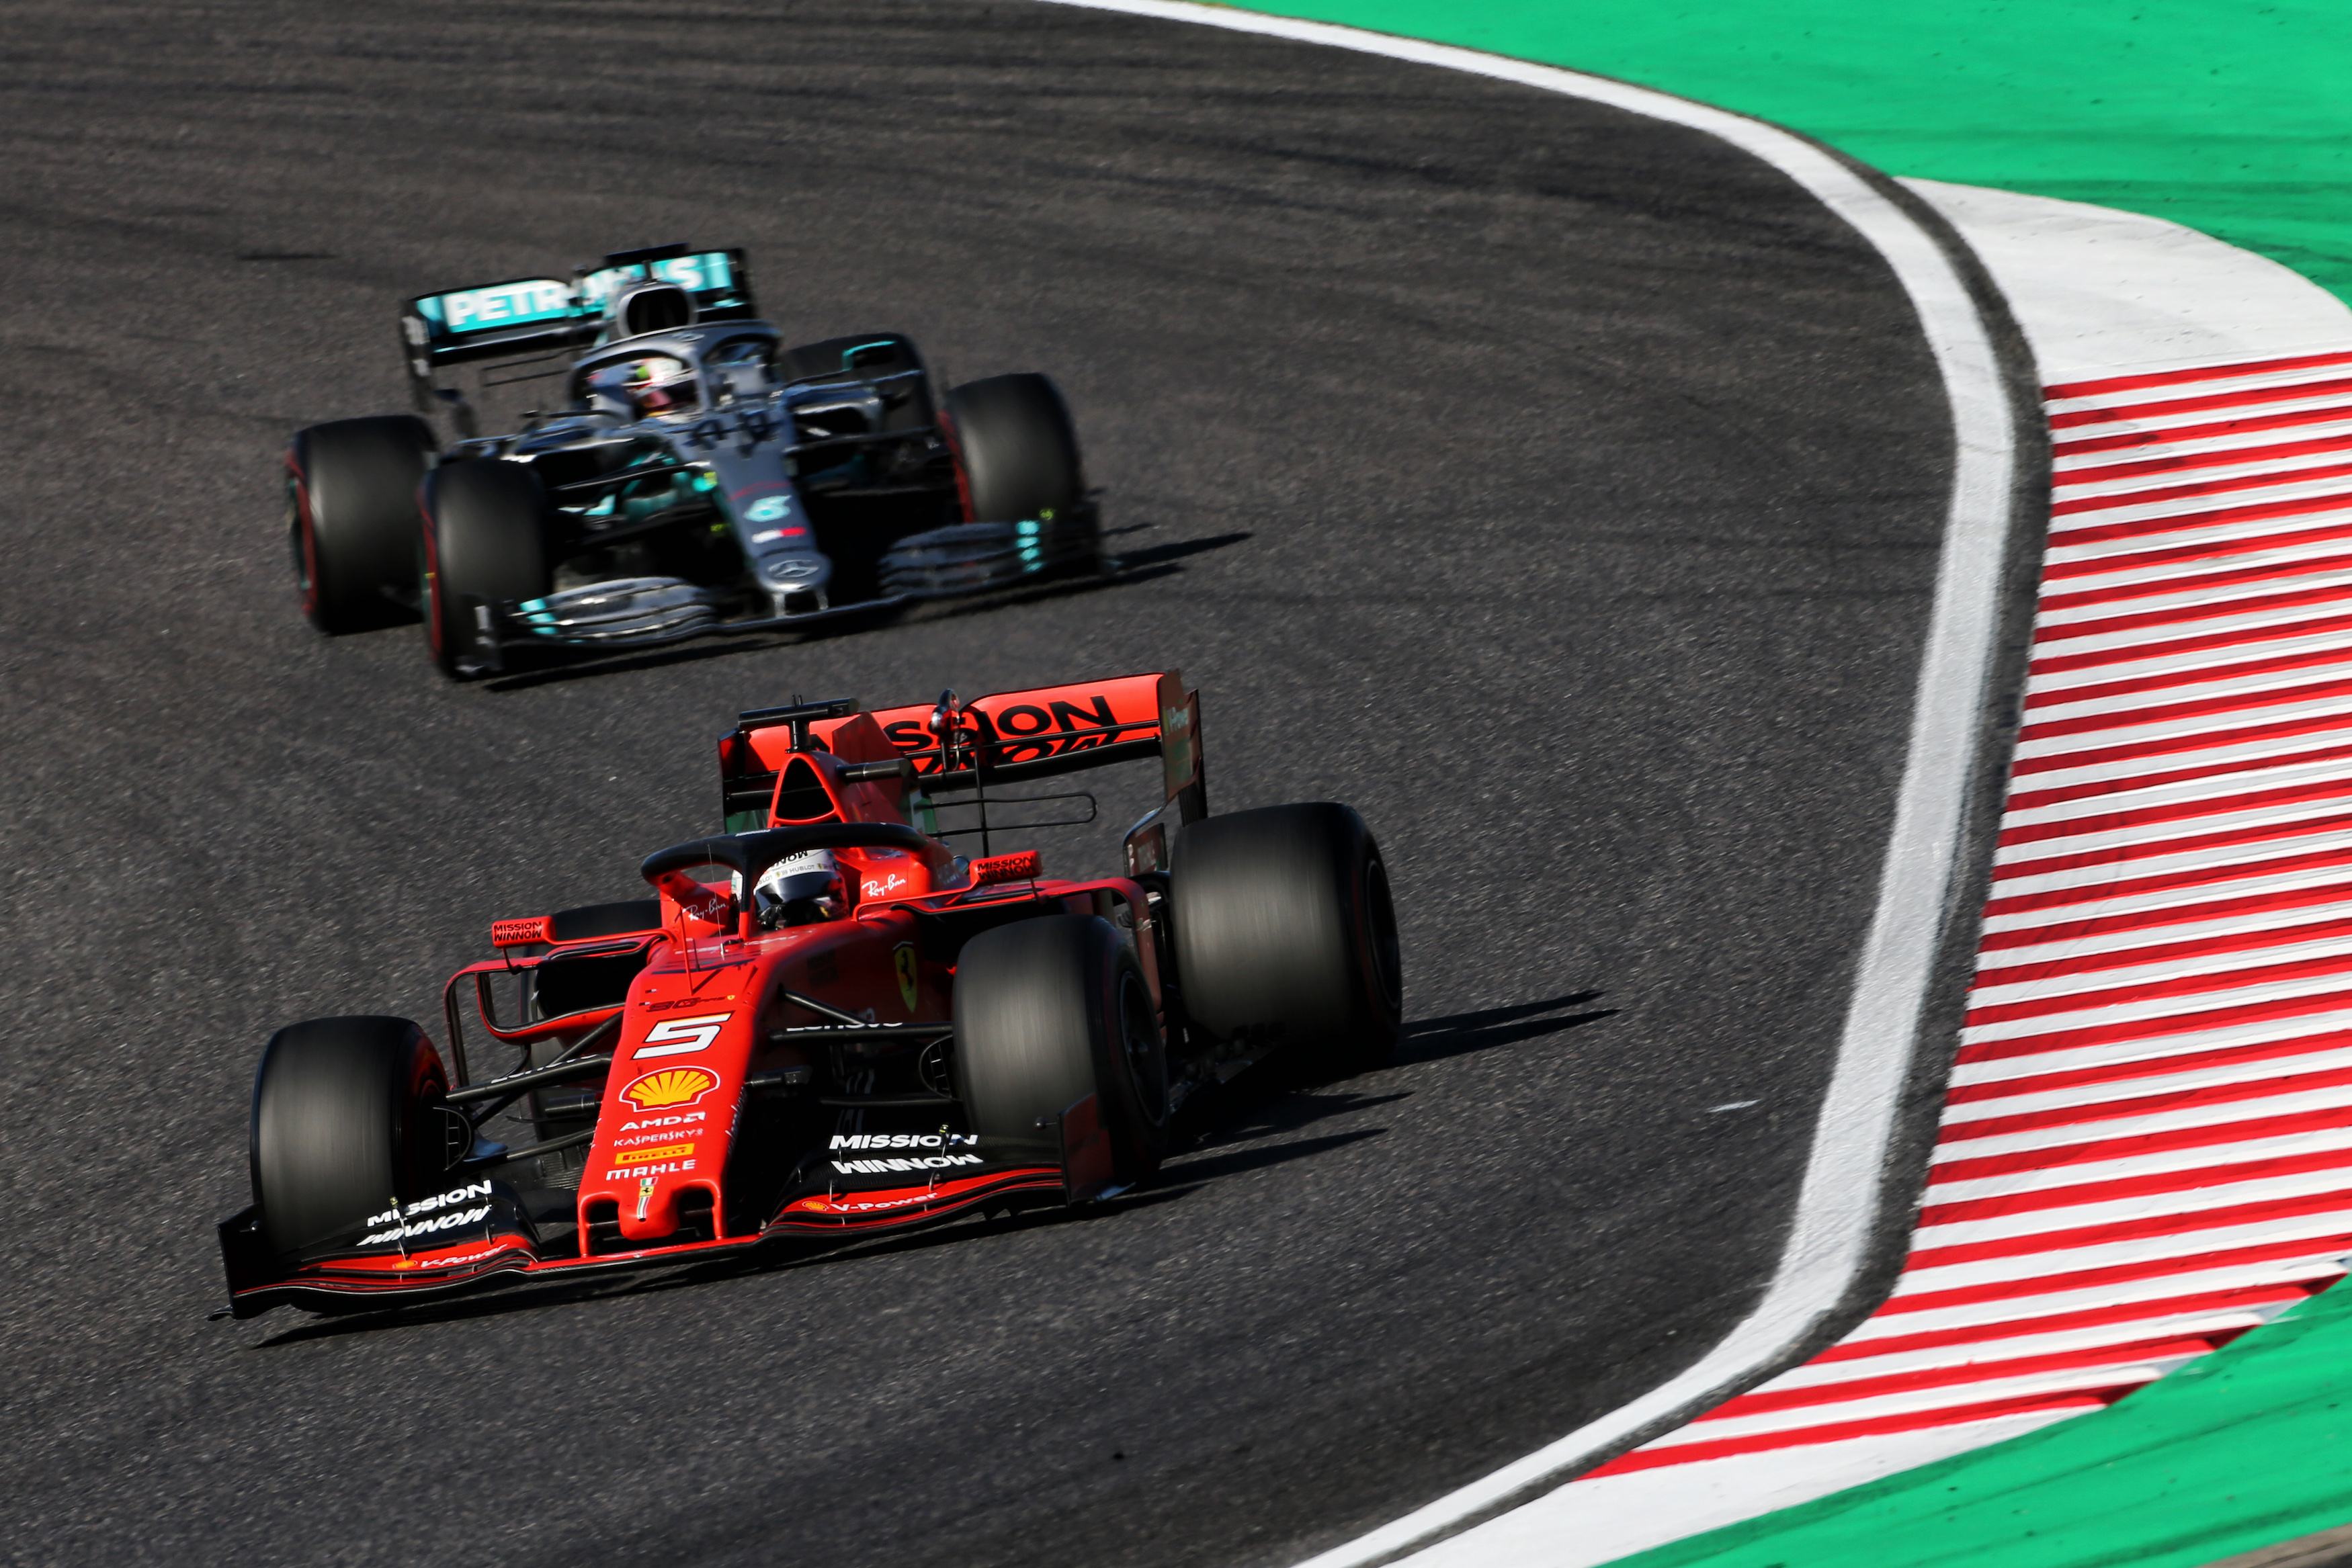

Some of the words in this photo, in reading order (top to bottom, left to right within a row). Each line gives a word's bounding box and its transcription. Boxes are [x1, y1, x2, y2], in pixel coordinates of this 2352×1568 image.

[443, 257, 704, 326] PETRS
[790, 865, 815, 873] HUBLOT
[977, 855, 1034, 871] MISSION
[978, 865, 1036, 880] WINNOW
[862, 873, 906, 897] Ray-Ban
[493, 921, 542, 932] MISSION
[494, 930, 542, 942] WINNOW
[630, 1010, 737, 1061] 5
[620, 1116, 682, 1131] AMD
[829, 1134, 978, 1149] MISSION
[606, 1159, 697, 1180] MAHLE
[831, 1153, 984, 1174] WINNOW
[367, 1180, 493, 1227] MISSION
[830, 1192, 938, 1212] V-Power
[356, 1205, 493, 1246] WINNOW
[421, 1244, 508, 1268] V-Power
